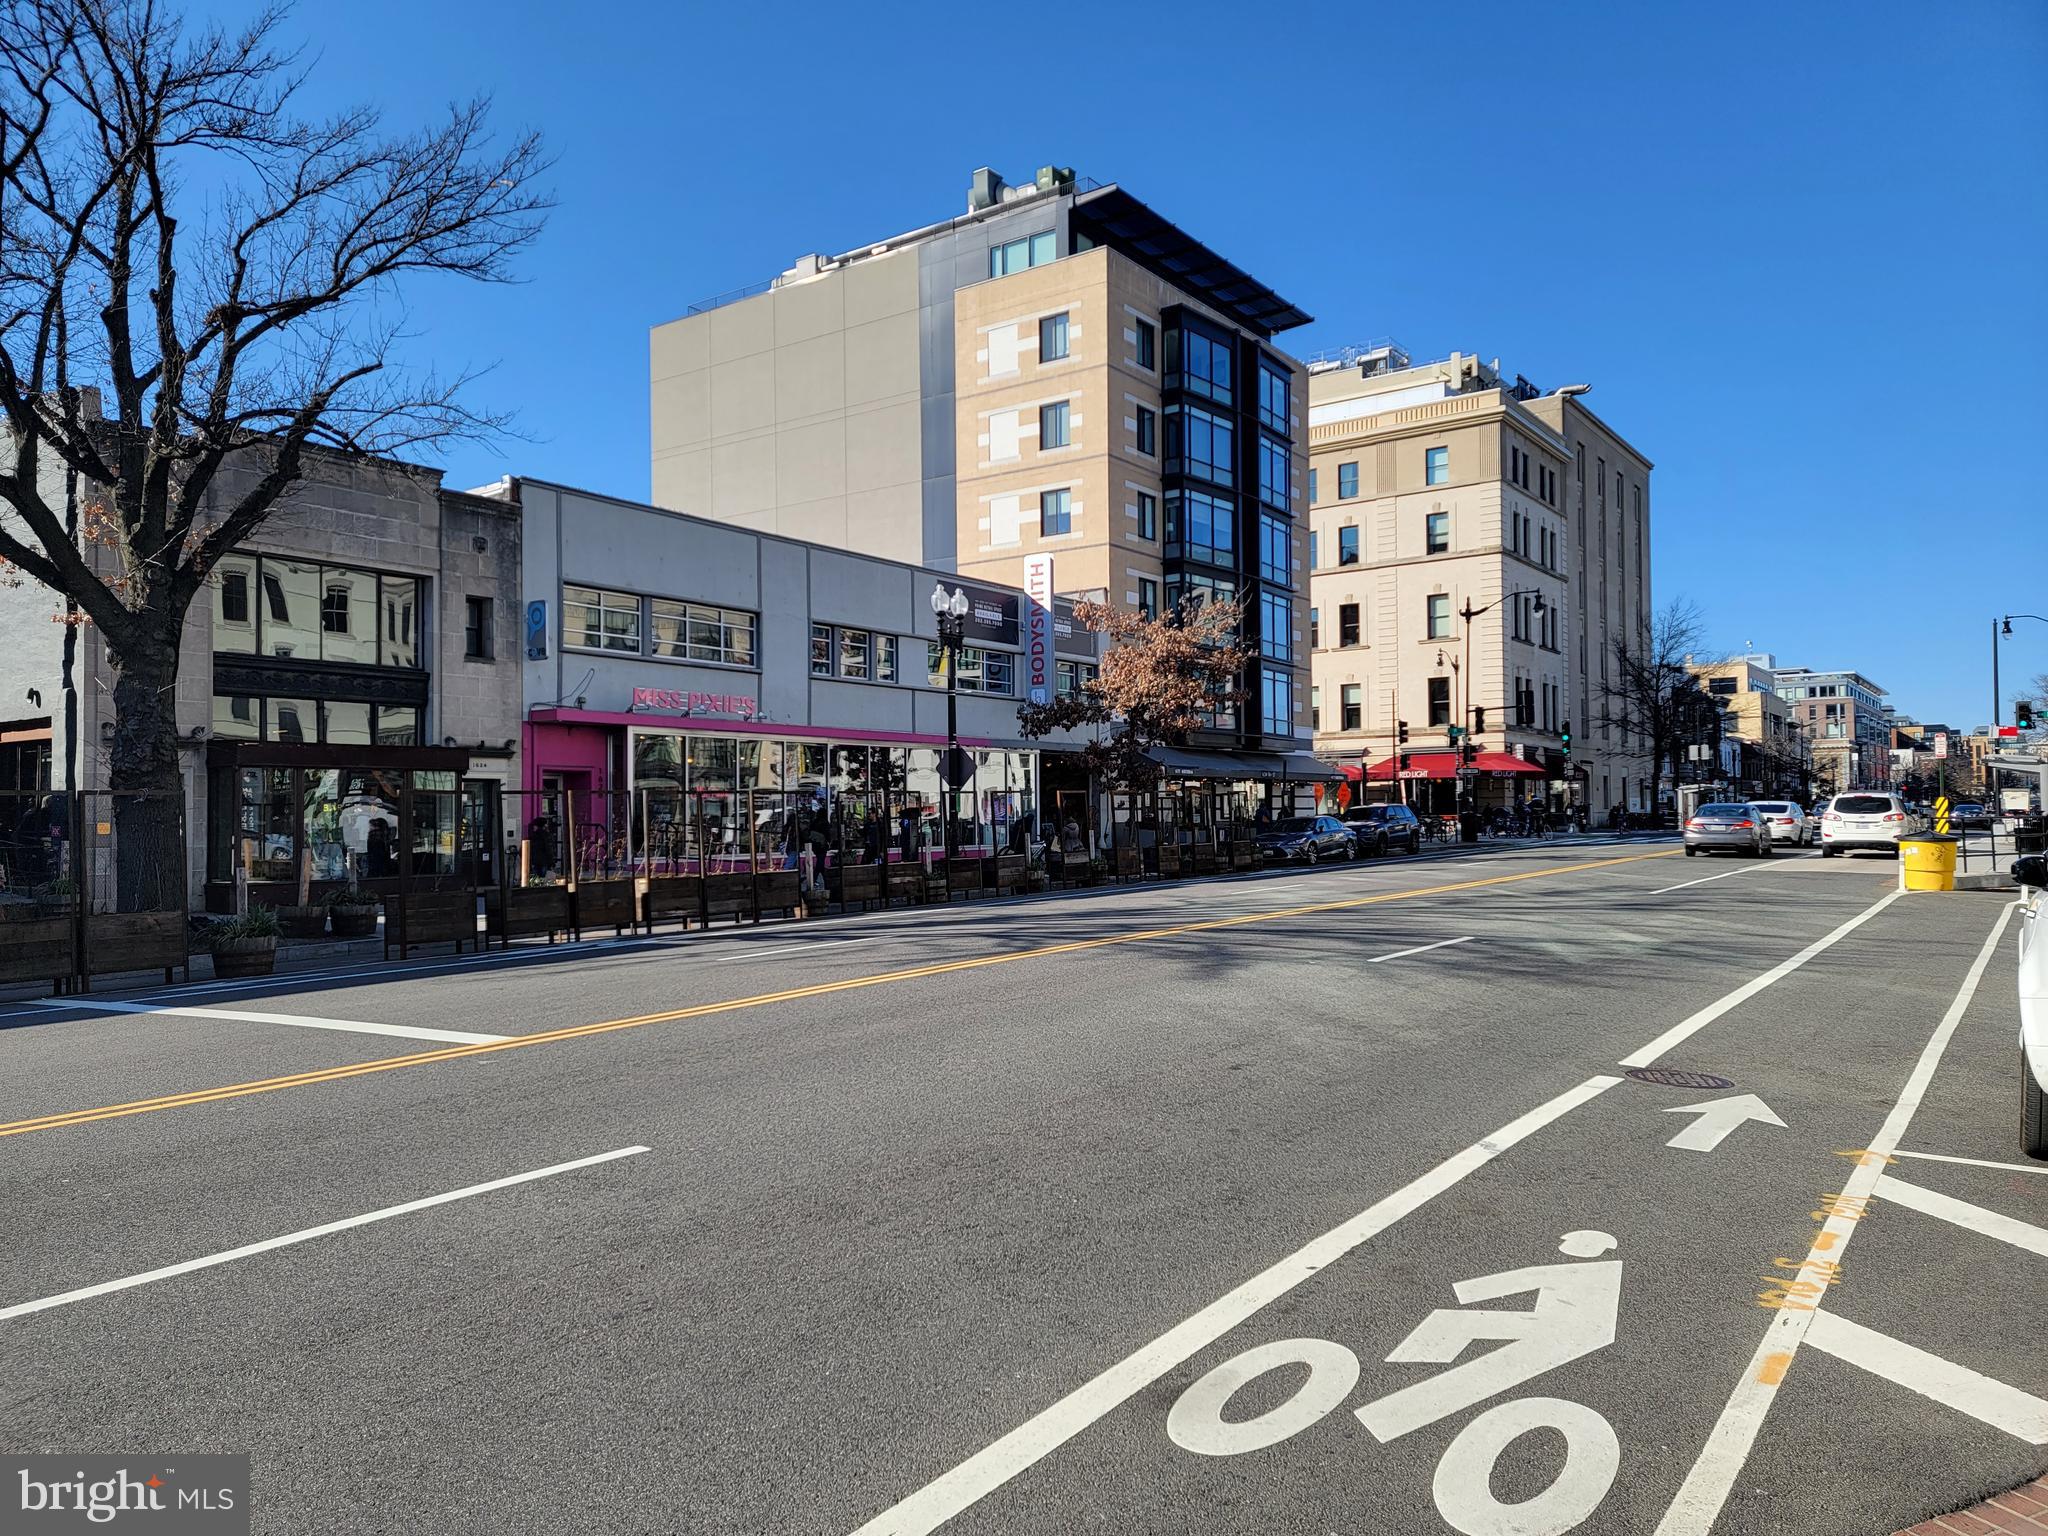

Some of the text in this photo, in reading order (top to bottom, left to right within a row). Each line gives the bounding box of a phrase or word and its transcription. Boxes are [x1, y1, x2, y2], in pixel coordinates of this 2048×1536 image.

[1030, 563, 1044, 686] BODYSMITH
[633, 687, 755, 715] MISS PIXIE'S
